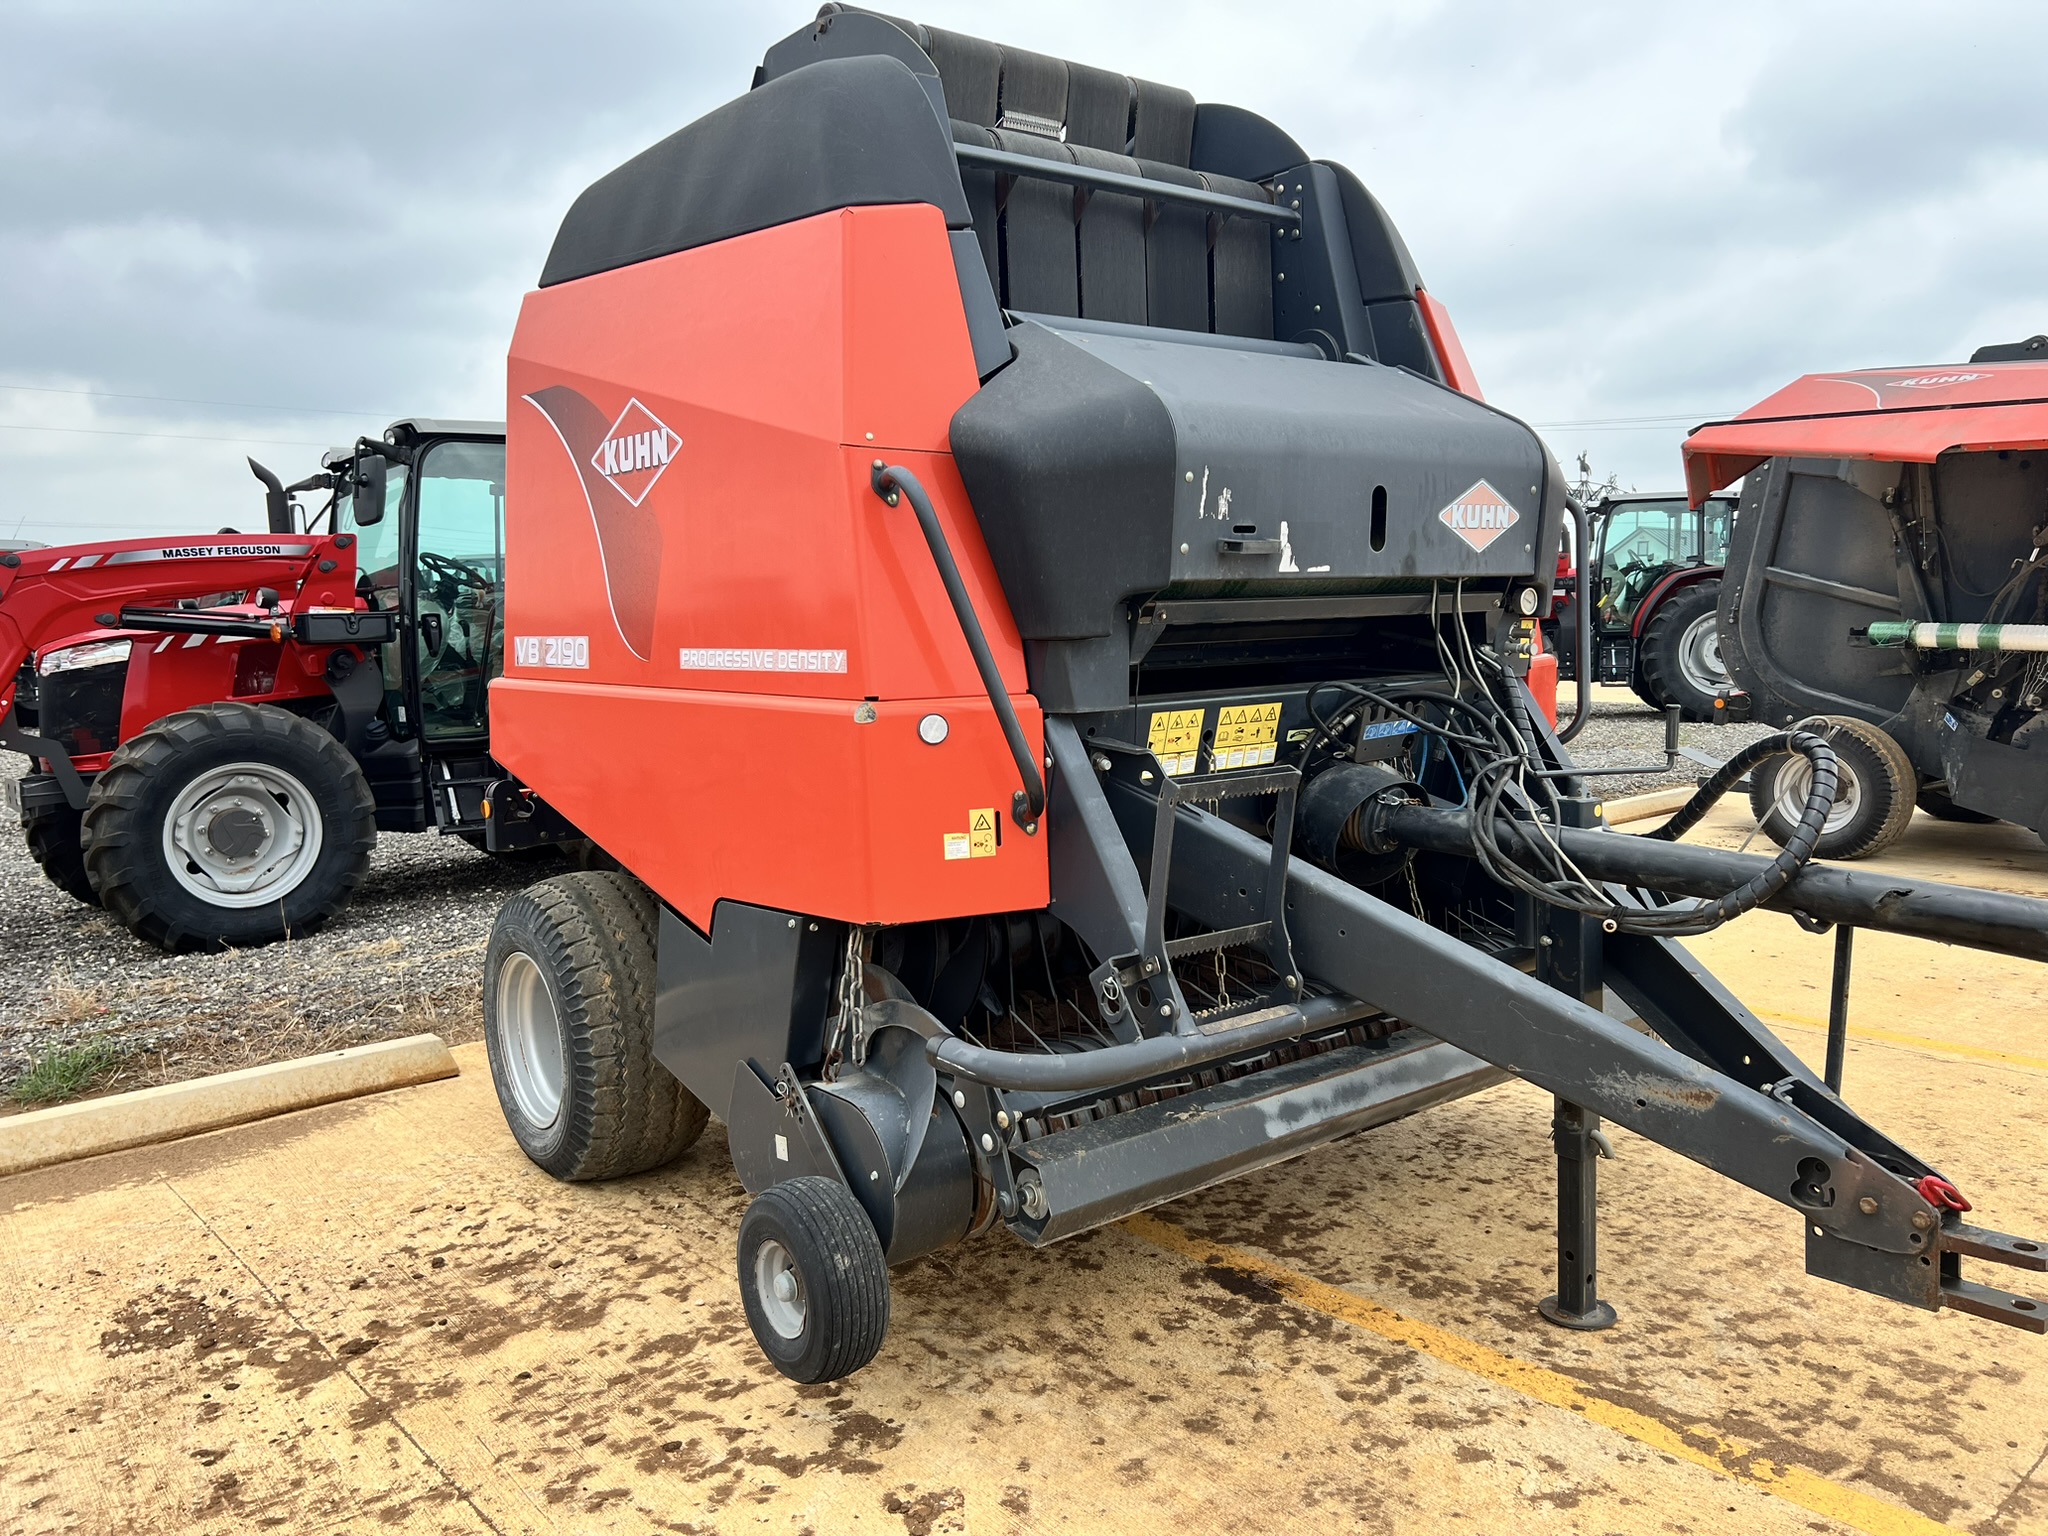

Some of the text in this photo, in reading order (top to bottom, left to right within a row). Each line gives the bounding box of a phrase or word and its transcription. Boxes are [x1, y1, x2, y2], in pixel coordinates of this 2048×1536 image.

[1900, 373, 1979, 387] KUHN
[604, 427, 668, 476] KUHN
[1451, 504, 1510, 530] KUHN
[162, 545, 281, 559] MASSEY FERGUSON
[516, 637, 587, 667] VB 2190
[681, 650, 774, 669] PROGRESSIVE
